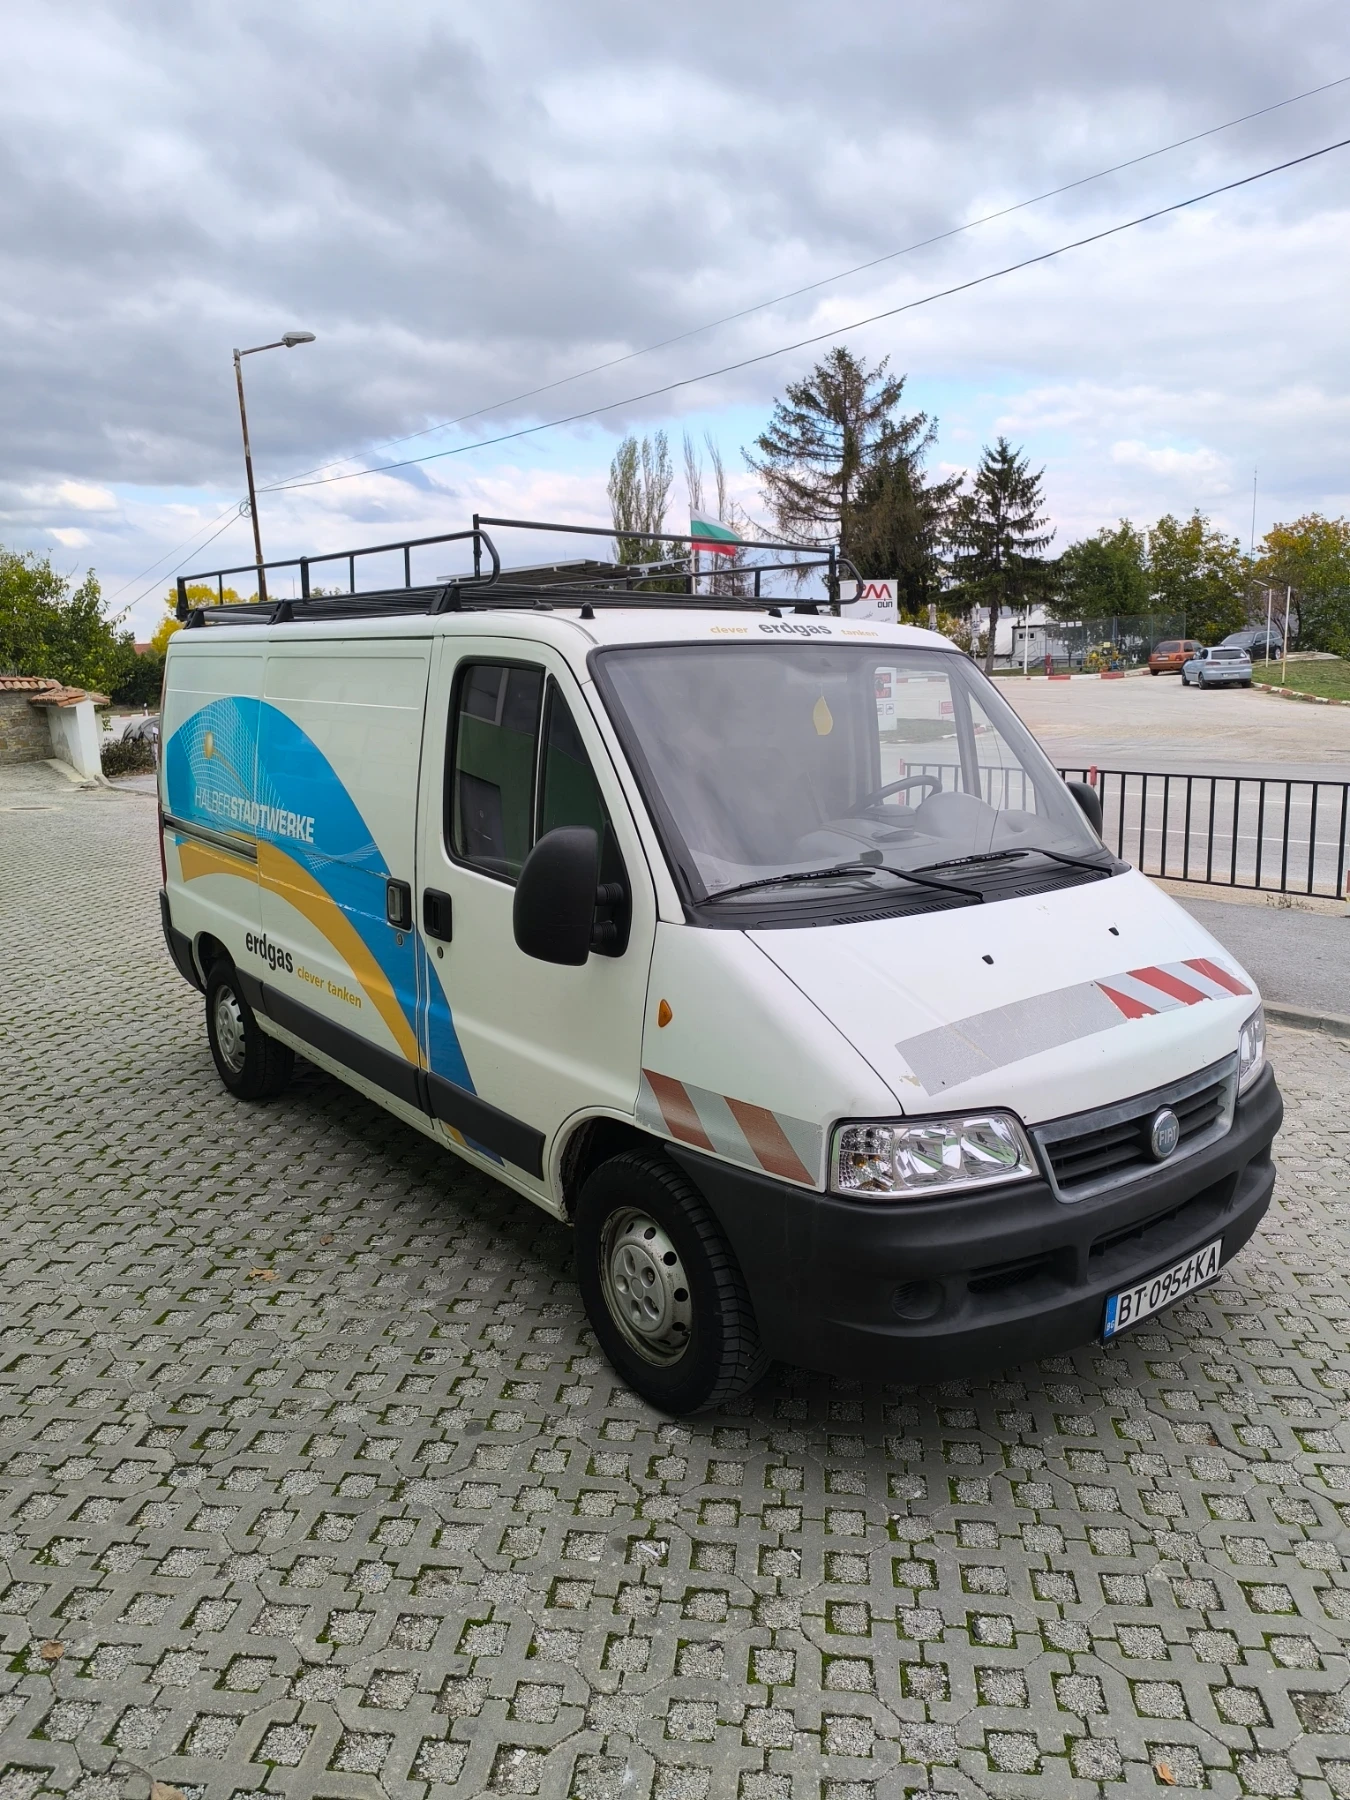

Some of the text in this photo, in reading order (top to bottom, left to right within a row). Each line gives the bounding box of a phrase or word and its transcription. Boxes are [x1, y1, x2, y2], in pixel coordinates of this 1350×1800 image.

[709, 622, 879, 637] clever erdgas tanken
[245, 932, 362, 1008] erdgas clever tanken
[1158, 1125, 1177, 1146] FIAT
